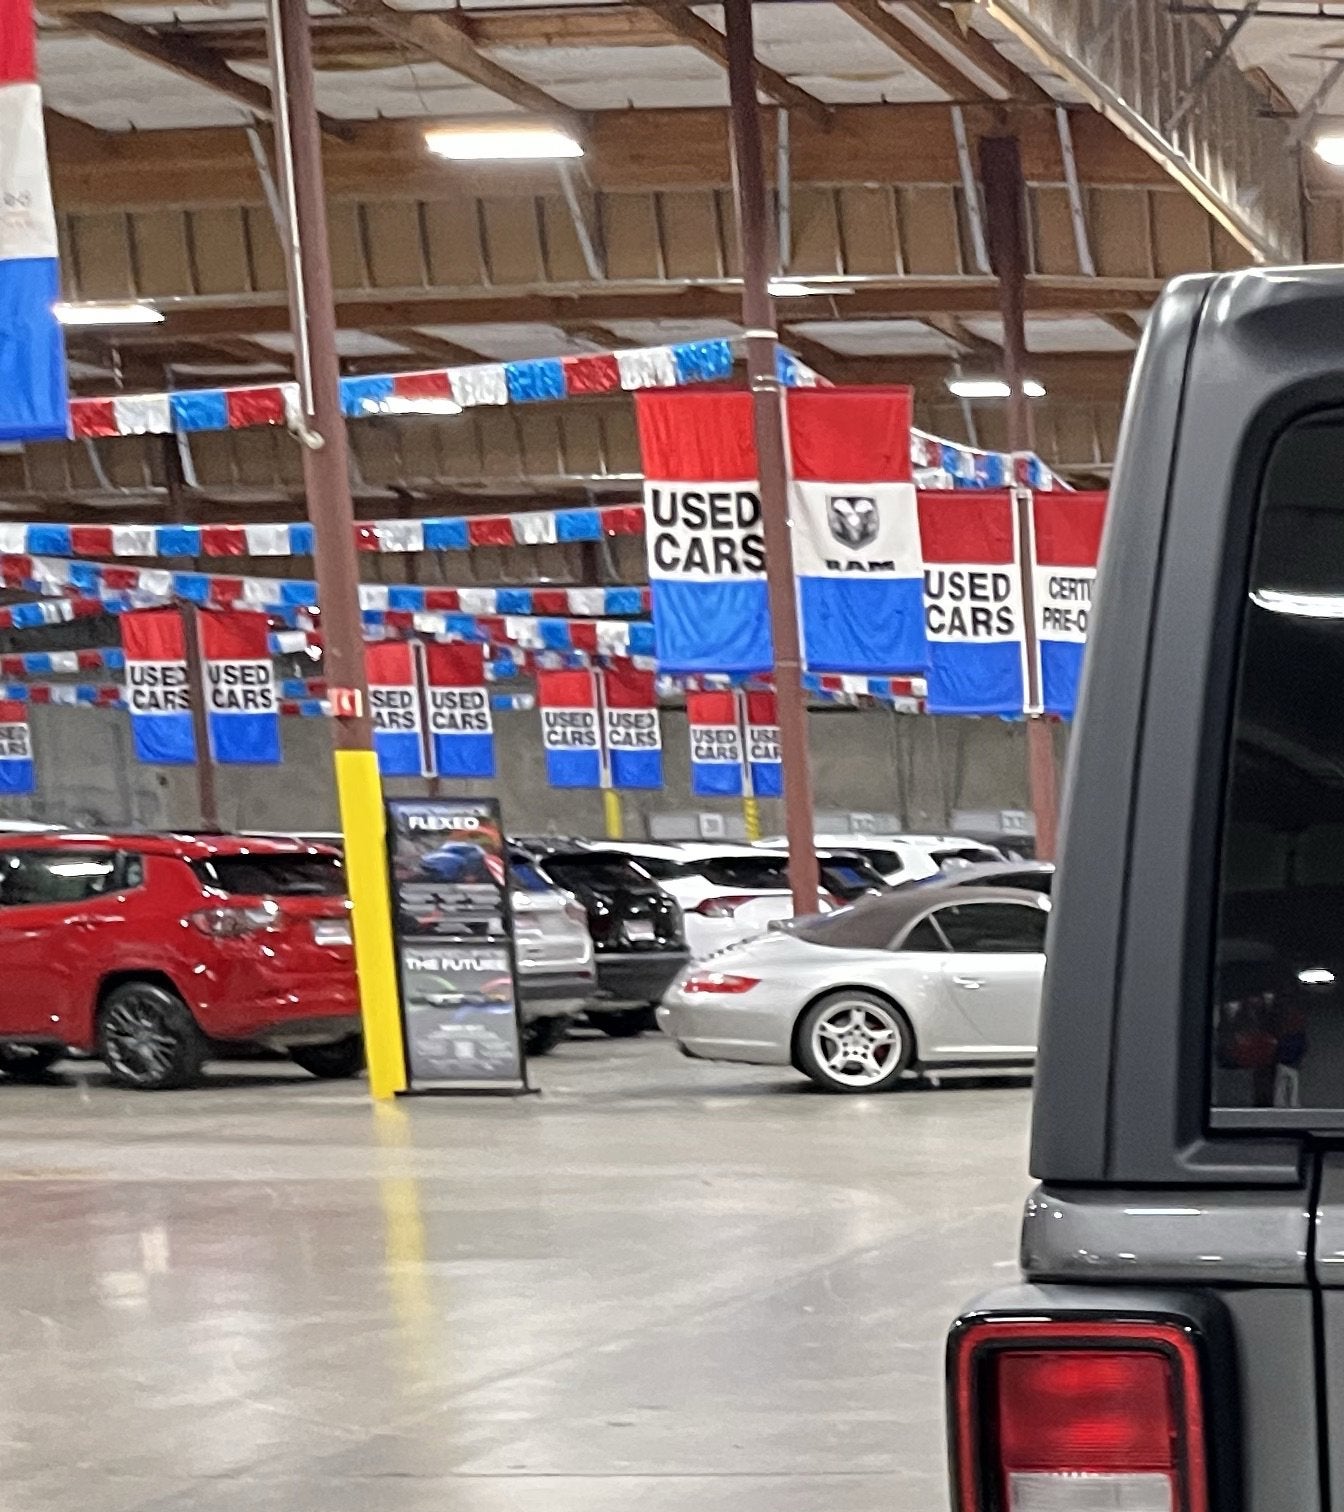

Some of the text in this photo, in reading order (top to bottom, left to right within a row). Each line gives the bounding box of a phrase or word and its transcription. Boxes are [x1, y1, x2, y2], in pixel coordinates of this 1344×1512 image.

[652, 489, 761, 531] USED
[654, 533, 767, 574] CARS
[825, 560, 895, 572] RAM
[924, 570, 1011, 603] USED
[1049, 576, 1096, 601] CERTI
[926, 604, 1015, 637] CARS
[1043, 606, 1088, 634] PRE-O
[130, 666, 187, 686] USED
[208, 665, 270, 685] USED
[133, 689, 189, 710] CARS
[212, 688, 272, 709] CARS
[372, 690, 412, 709] SED
[431, 691, 484, 709] USED
[374, 711, 415, 729] ARS
[433, 712, 488, 730] CARS
[545, 711, 594, 727] USED
[608, 712, 655, 728] USED
[549, 730, 596, 745] CARS
[609, 730, 657, 746] CARS
[692, 729, 737, 743] USED
[695, 746, 738, 759] CARS
